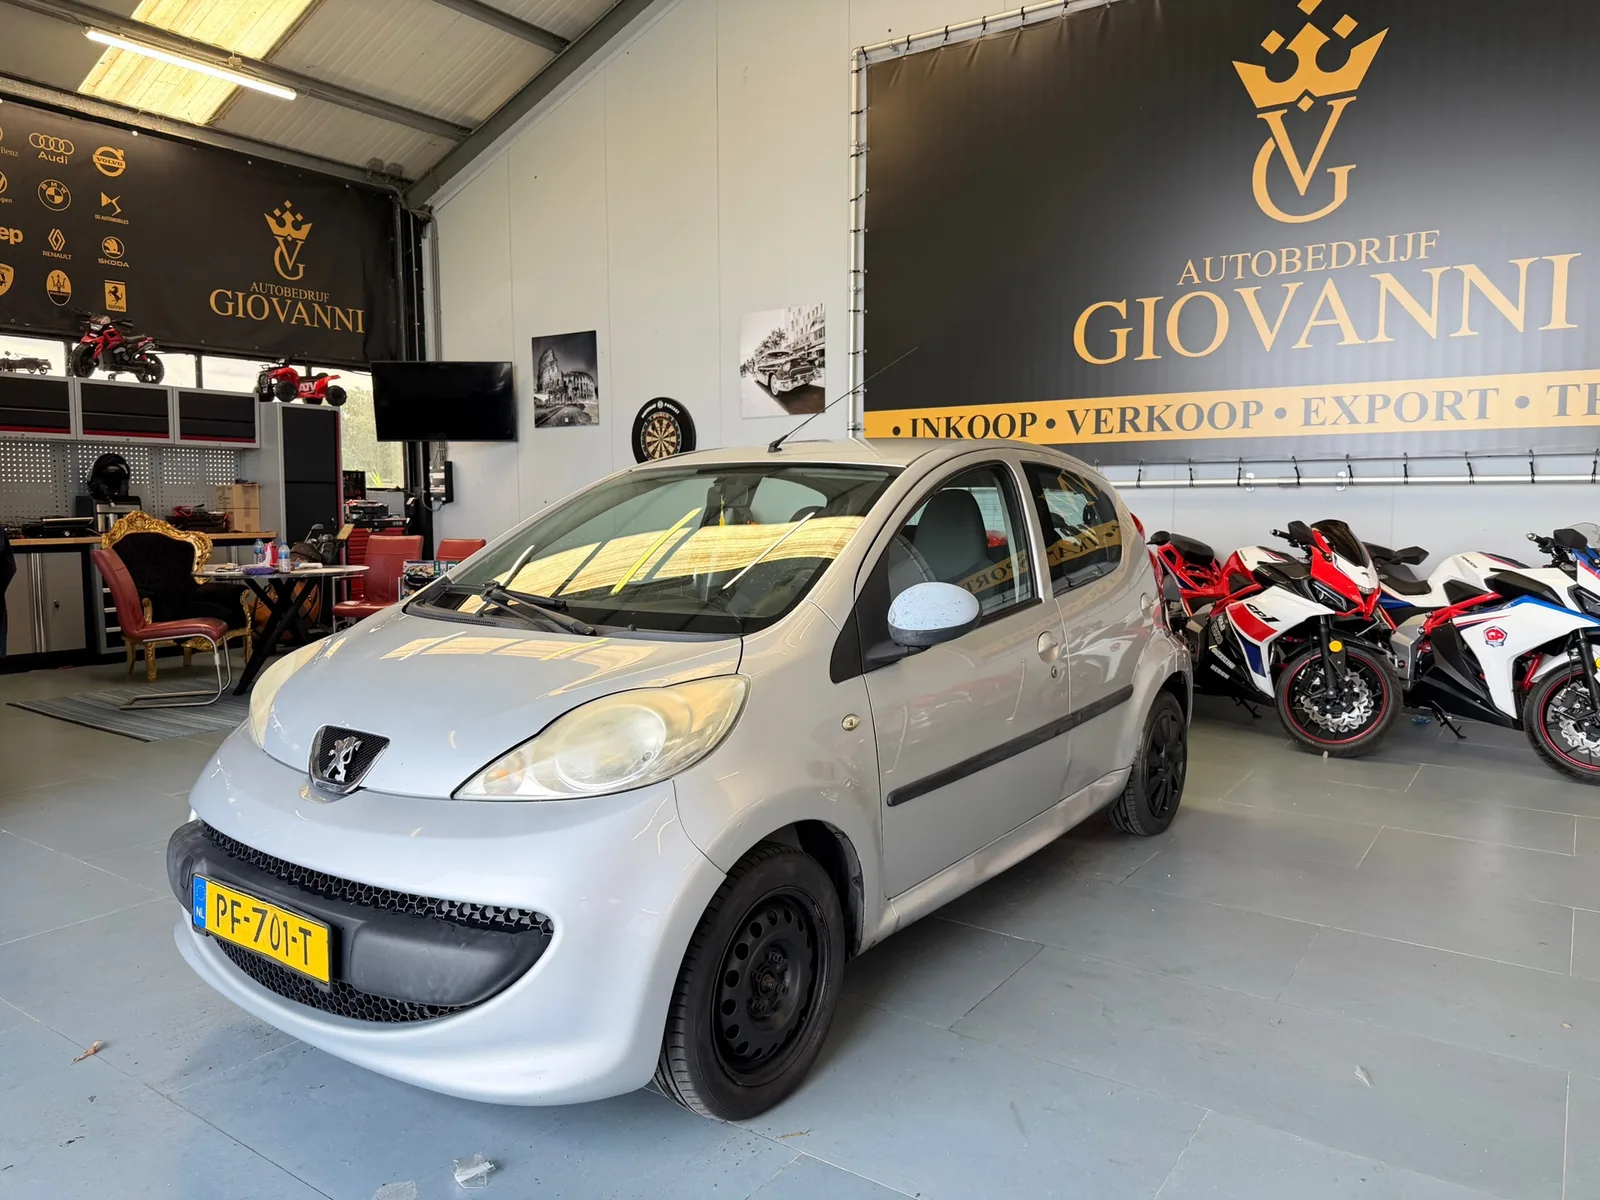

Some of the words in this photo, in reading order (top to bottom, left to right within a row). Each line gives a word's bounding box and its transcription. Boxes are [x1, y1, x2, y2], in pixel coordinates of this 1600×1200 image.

[38, 151, 68, 165] Audi
[96, 156, 123, 167] VOLVO
[40, 181, 69, 194] BMW
[42, 251, 72, 260] RENAULT
[1176, 229, 1440, 286] AUTOBEDRIJF
[250, 281, 330, 303] AUTOBEDRIJF
[209, 289, 365, 334] GIOVANNI
[1073, 252, 1582, 365] GIOVANNI
[299, 381, 318, 392] ATV
[909, 412, 1038, 440] INKOOP
[1065, 400, 1264, 436] VERKOOP
[1300, 387, 1500, 427] EXPORT
[195, 905, 205, 920] NL
[216, 893, 313, 966] PF-701-T
